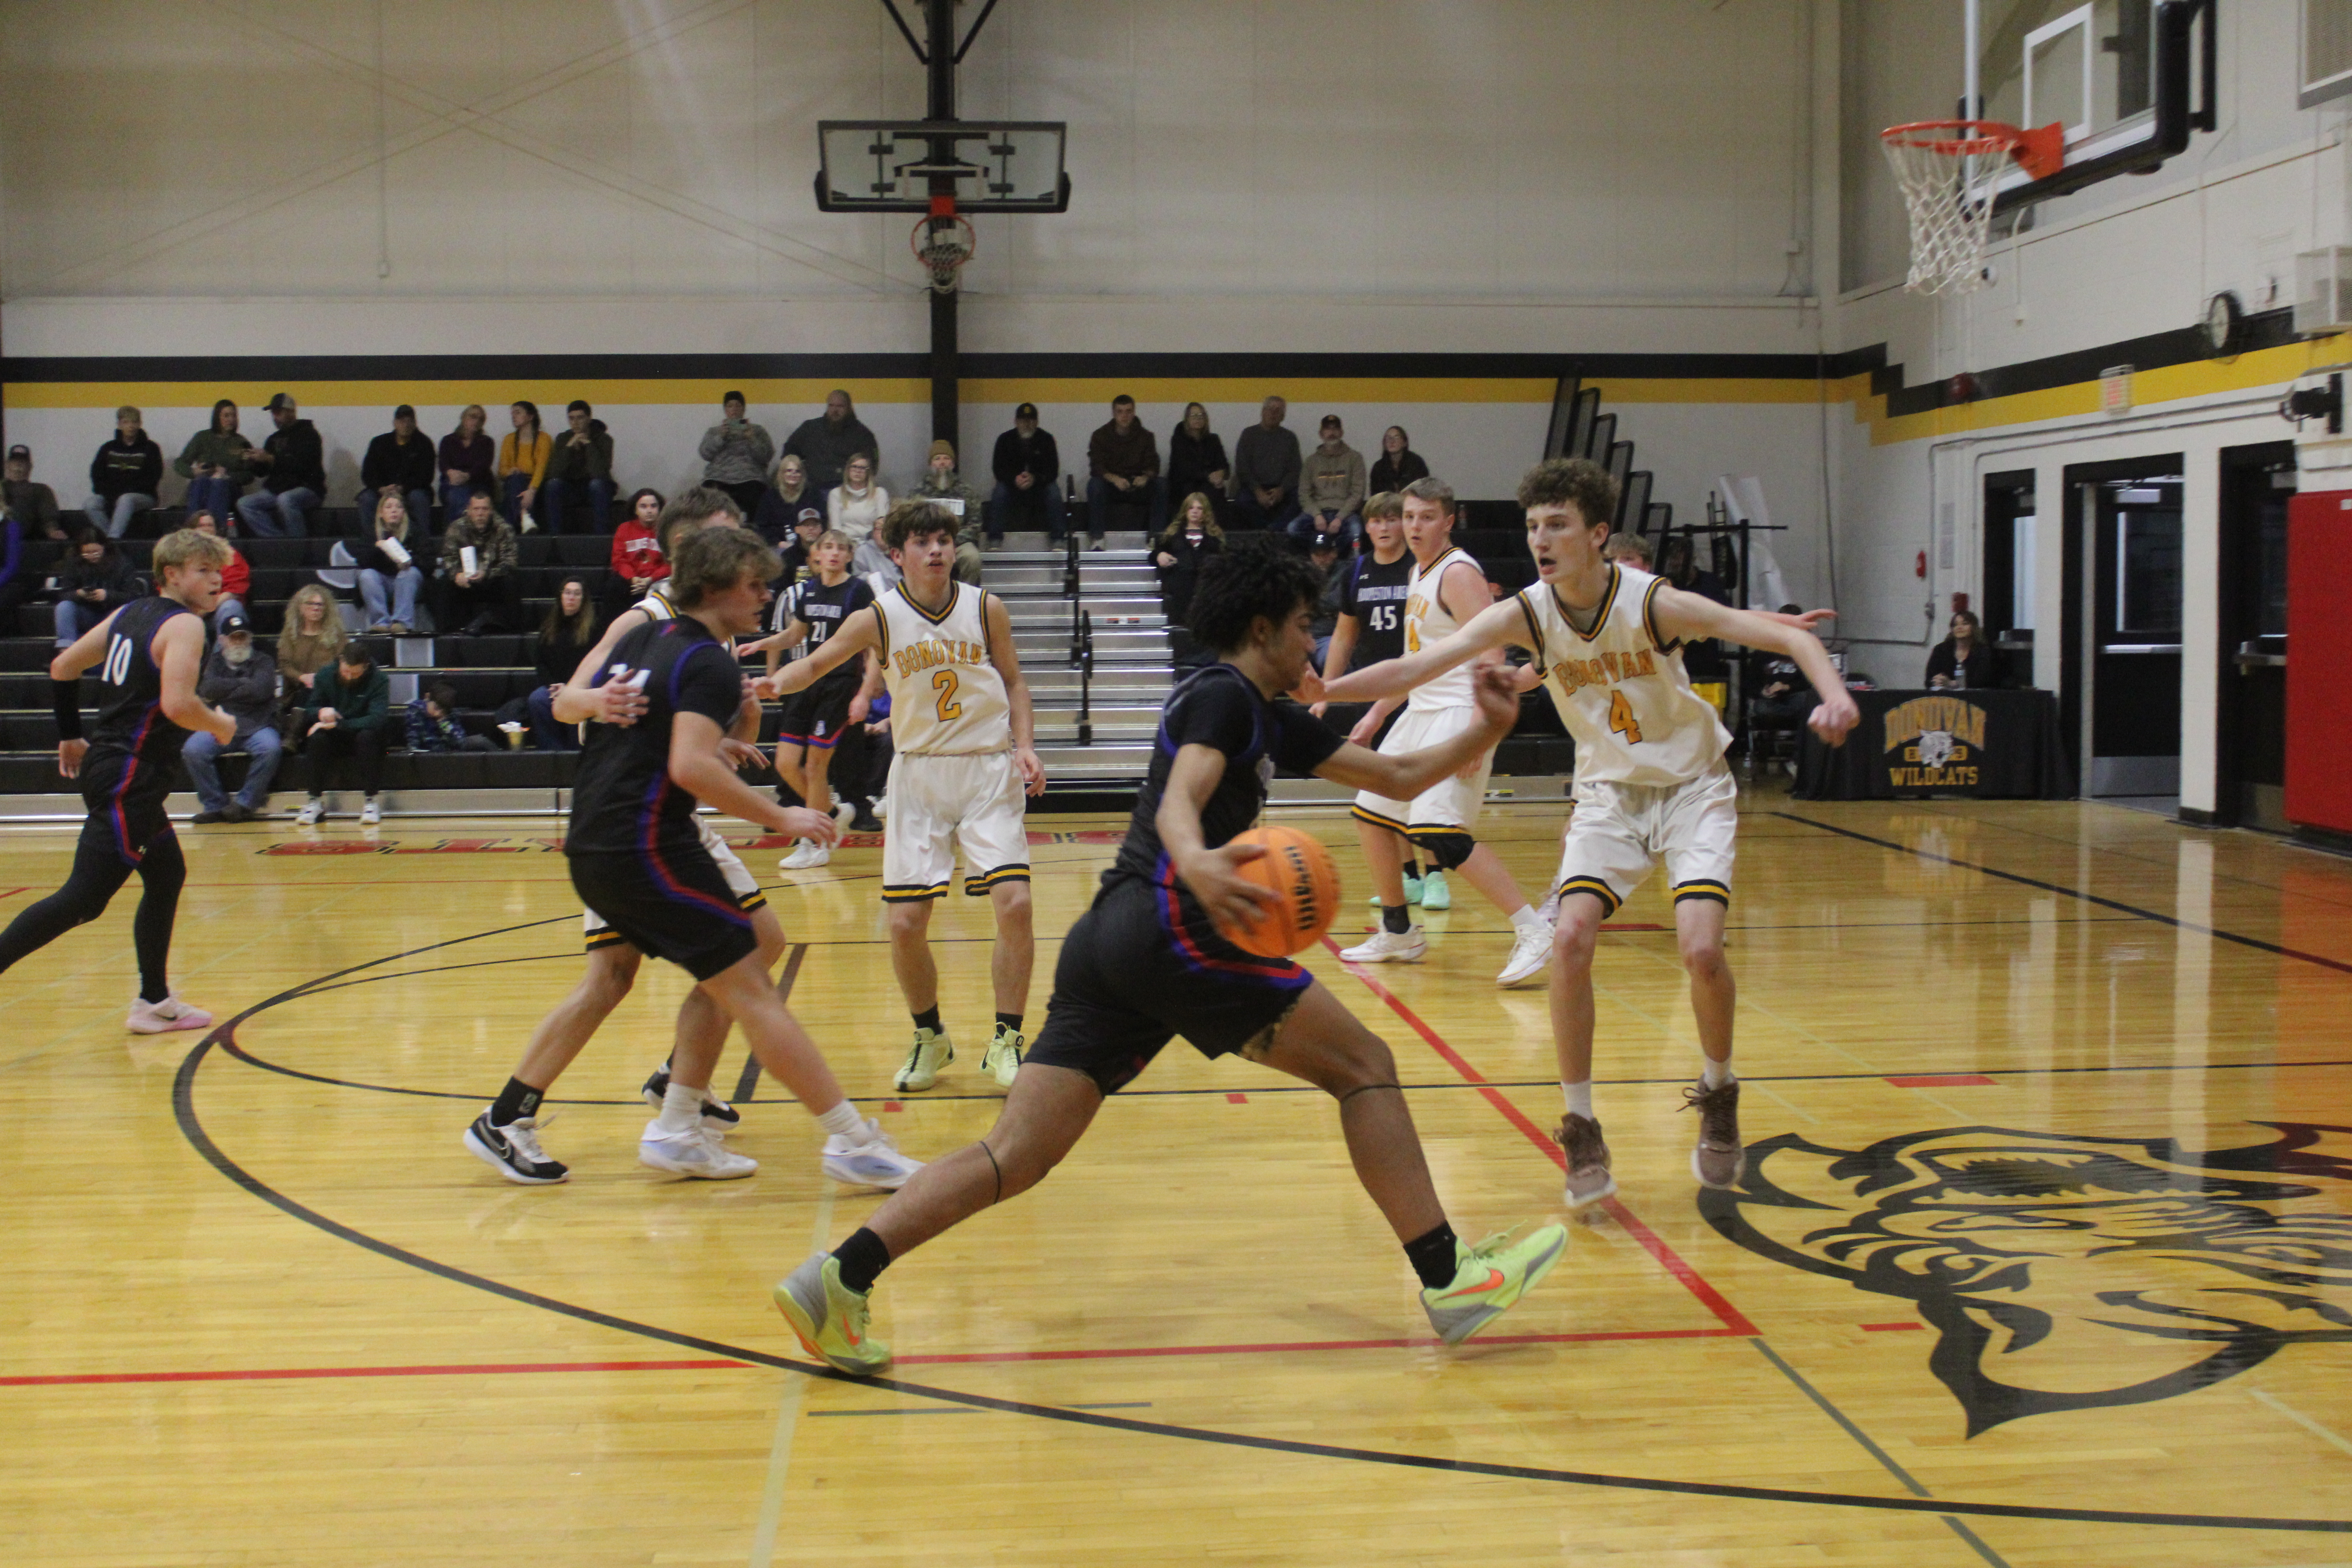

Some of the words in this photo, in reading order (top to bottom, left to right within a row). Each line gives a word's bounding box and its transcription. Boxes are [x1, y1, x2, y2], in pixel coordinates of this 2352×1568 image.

[810, 621, 827, 642] 21
[1369, 605, 1397, 631] 45
[101, 633, 133, 686] 10
[893, 639, 982, 679] DONOVAN
[1552, 648, 1657, 697] DONOVAN
[932, 669, 962, 722] 2
[1608, 690, 1643, 745] 4
[1884, 696, 1987, 754] DONOVAN
[1889, 766, 1978, 786] WILDCATS
